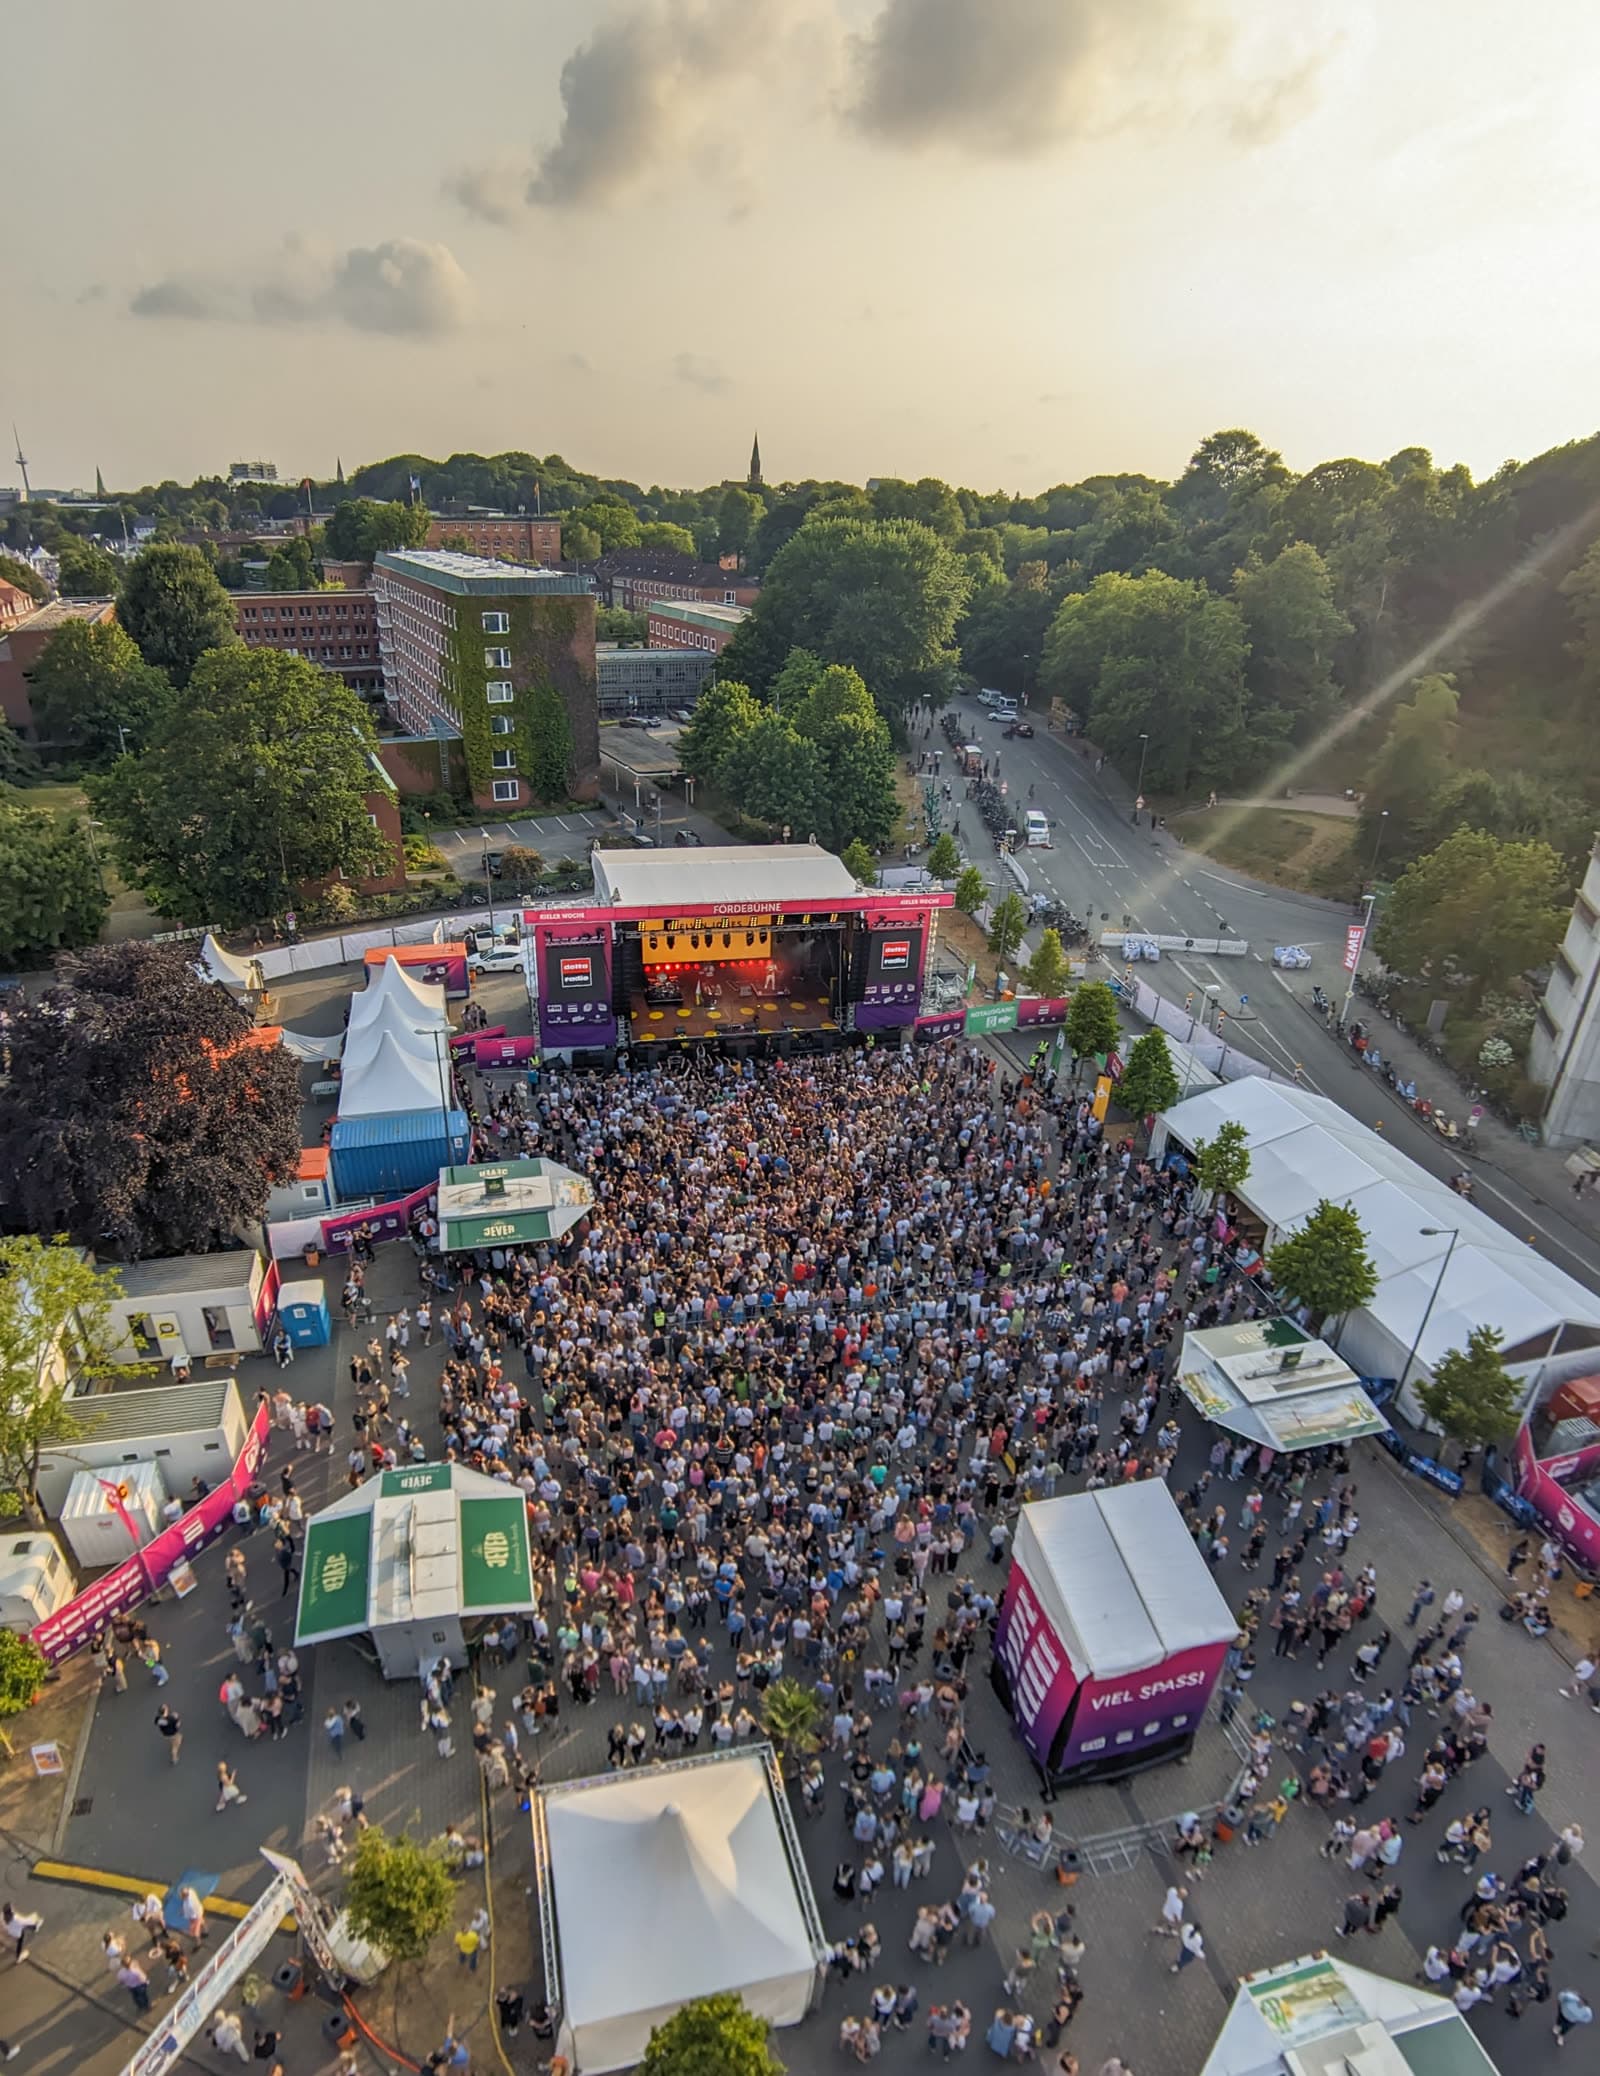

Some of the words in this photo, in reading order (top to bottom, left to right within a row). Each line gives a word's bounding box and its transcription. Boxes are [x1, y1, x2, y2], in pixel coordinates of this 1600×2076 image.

[713, 902, 782, 914] FÖRDEBÜHNE
[1344, 930, 1362, 969] REWE
[564, 975, 590, 983] radio
[483, 1224, 515, 1237] JEVER
[401, 1475, 433, 1489] JEVER
[483, 1531, 509, 1568] JEVER
[322, 1551, 347, 1593] JEVER
[1091, 1691, 1133, 1711] VIEL
[1139, 1670, 1206, 1700] SPASS!
